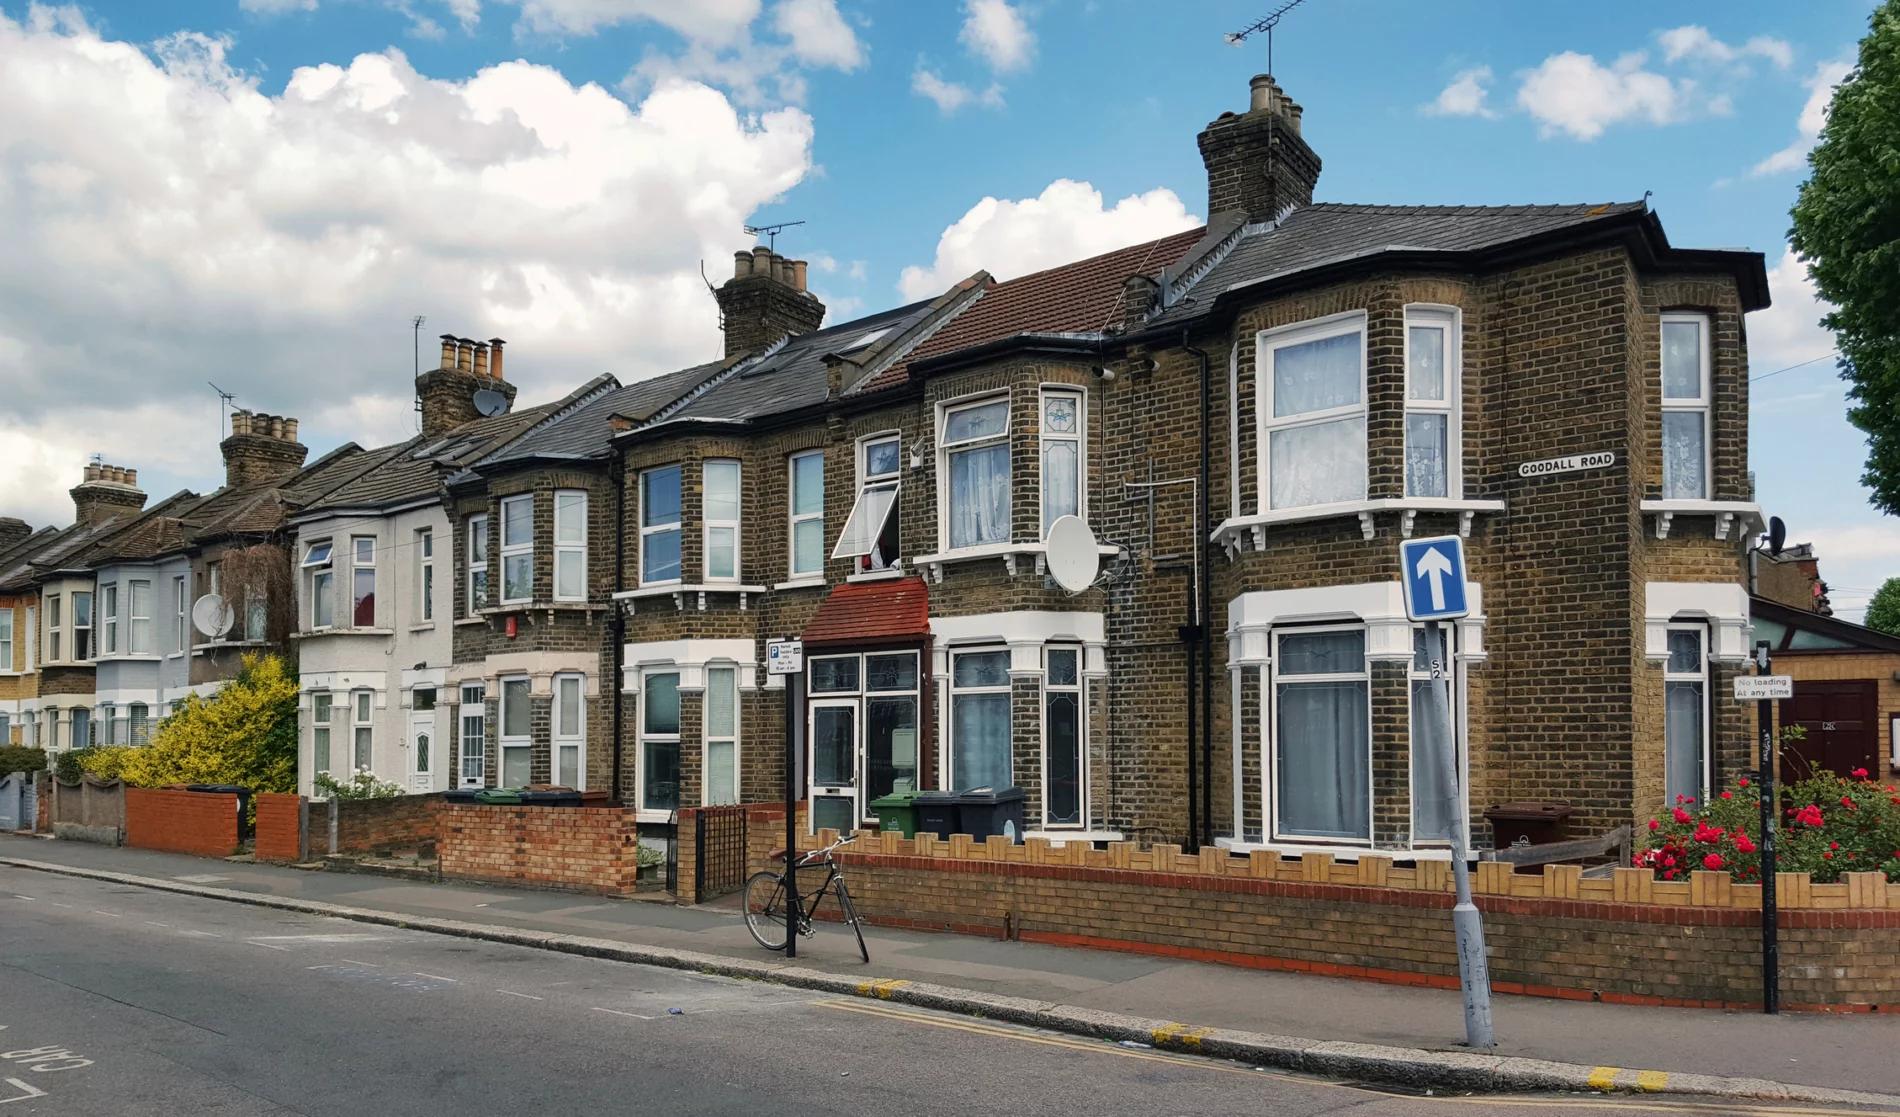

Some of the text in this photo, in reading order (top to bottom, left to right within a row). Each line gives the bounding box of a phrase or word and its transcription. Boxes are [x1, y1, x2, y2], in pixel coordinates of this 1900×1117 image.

[1522, 454, 1612, 475] GOODALL ROAD
[0, 1045, 95, 1072] CAR
